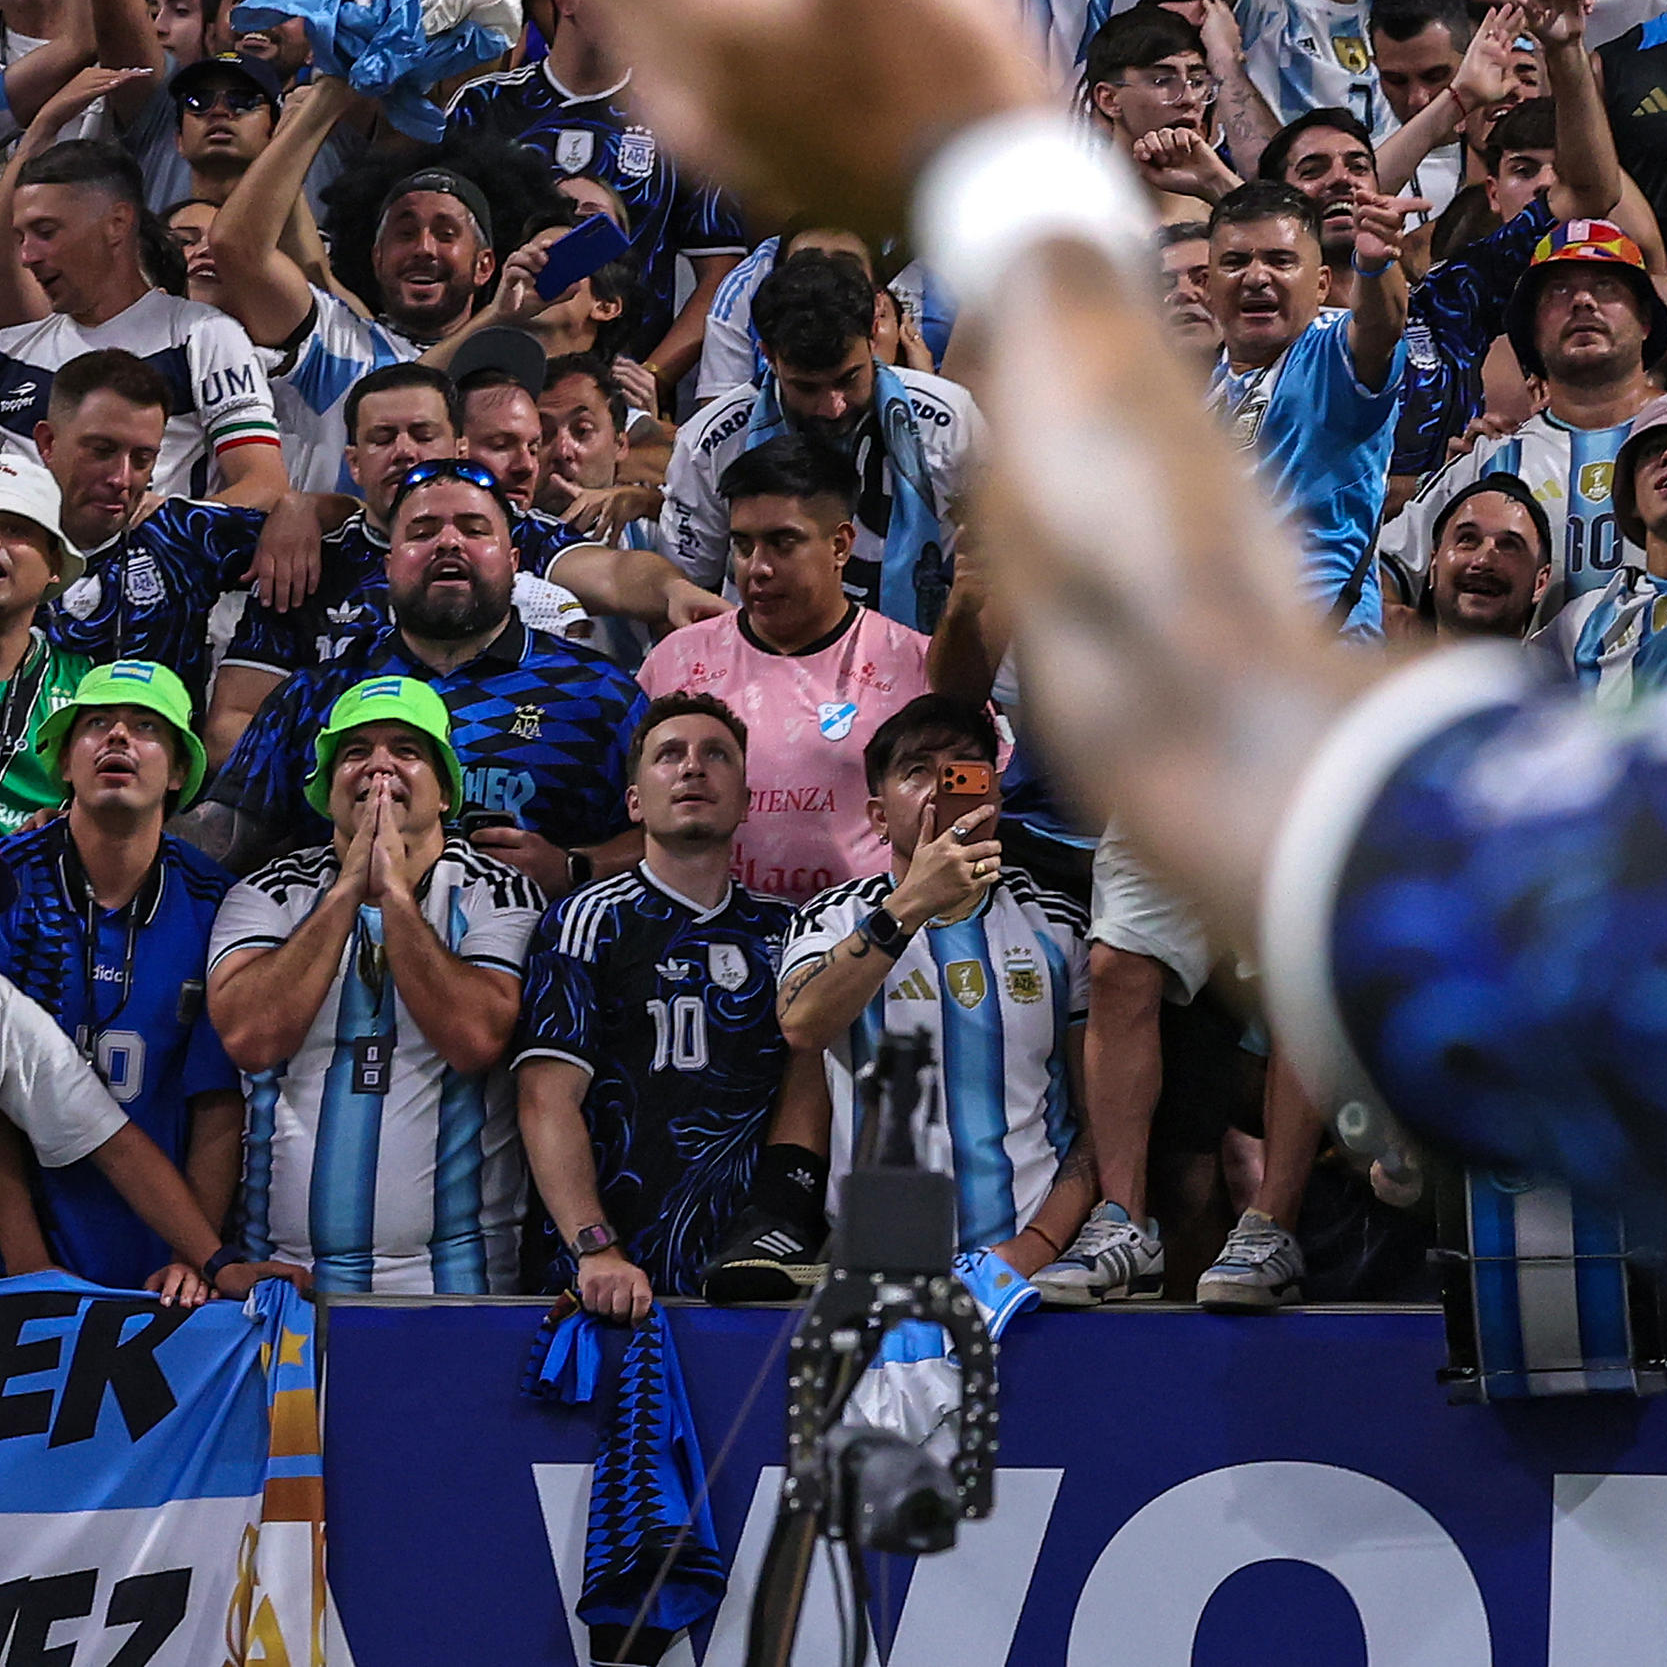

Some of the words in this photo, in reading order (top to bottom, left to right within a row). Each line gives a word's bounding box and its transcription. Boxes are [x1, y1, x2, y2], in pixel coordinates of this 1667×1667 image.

[1566, 511, 1624, 573] 10
[508, 714, 543, 740] AFA
[646, 995, 711, 1072] 10
